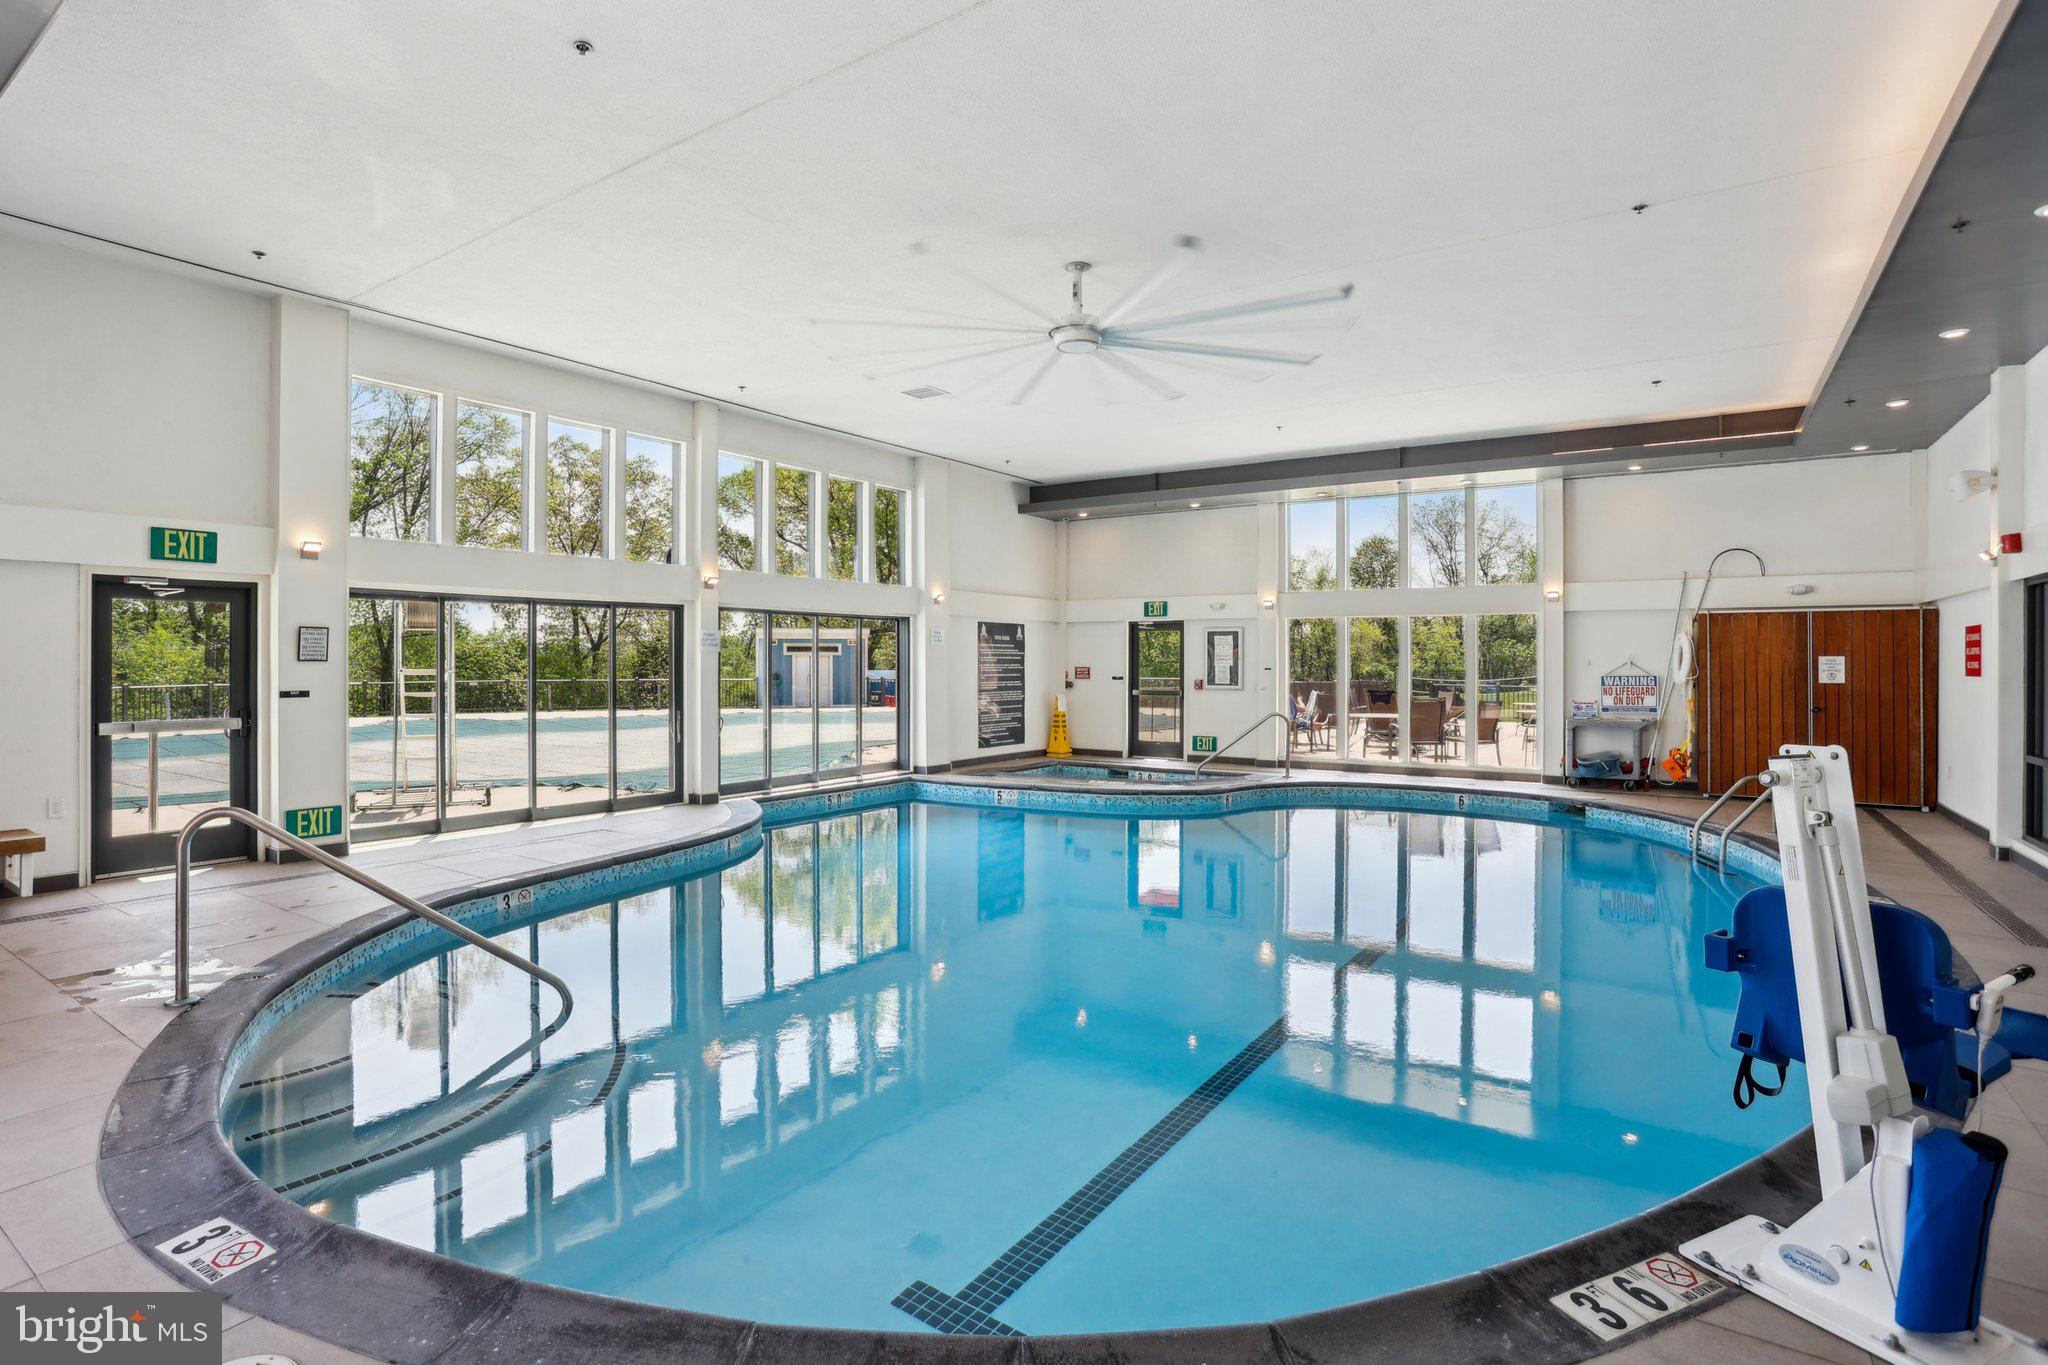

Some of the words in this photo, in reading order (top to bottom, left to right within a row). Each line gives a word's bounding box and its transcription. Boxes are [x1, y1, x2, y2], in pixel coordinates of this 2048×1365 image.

[164, 529, 208, 560] EXIT
[1148, 602, 1164, 616] EXIT
[1603, 676, 1655, 686] WARNING
[1602, 686, 1613, 696] NO
[1615, 686, 1656, 696] LIFEGUARD
[1613, 696, 1624, 706] ON
[1626, 696, 1645, 705] DUTY
[1197, 737, 1214, 750] EXIT
[297, 807, 334, 837] EXIT
[503, 894, 511, 910] 3
[170, 1225, 232, 1255] 3
[187, 1257, 206, 1269] NO
[196, 1263, 224, 1282] DIVING
[1585, 1284, 1605, 1298] FT
[1612, 1276, 1669, 1312] 6
[1680, 1290, 1698, 1301] NO
[1696, 1279, 1724, 1297] DIVING
[1569, 1292, 1628, 1330] 3
